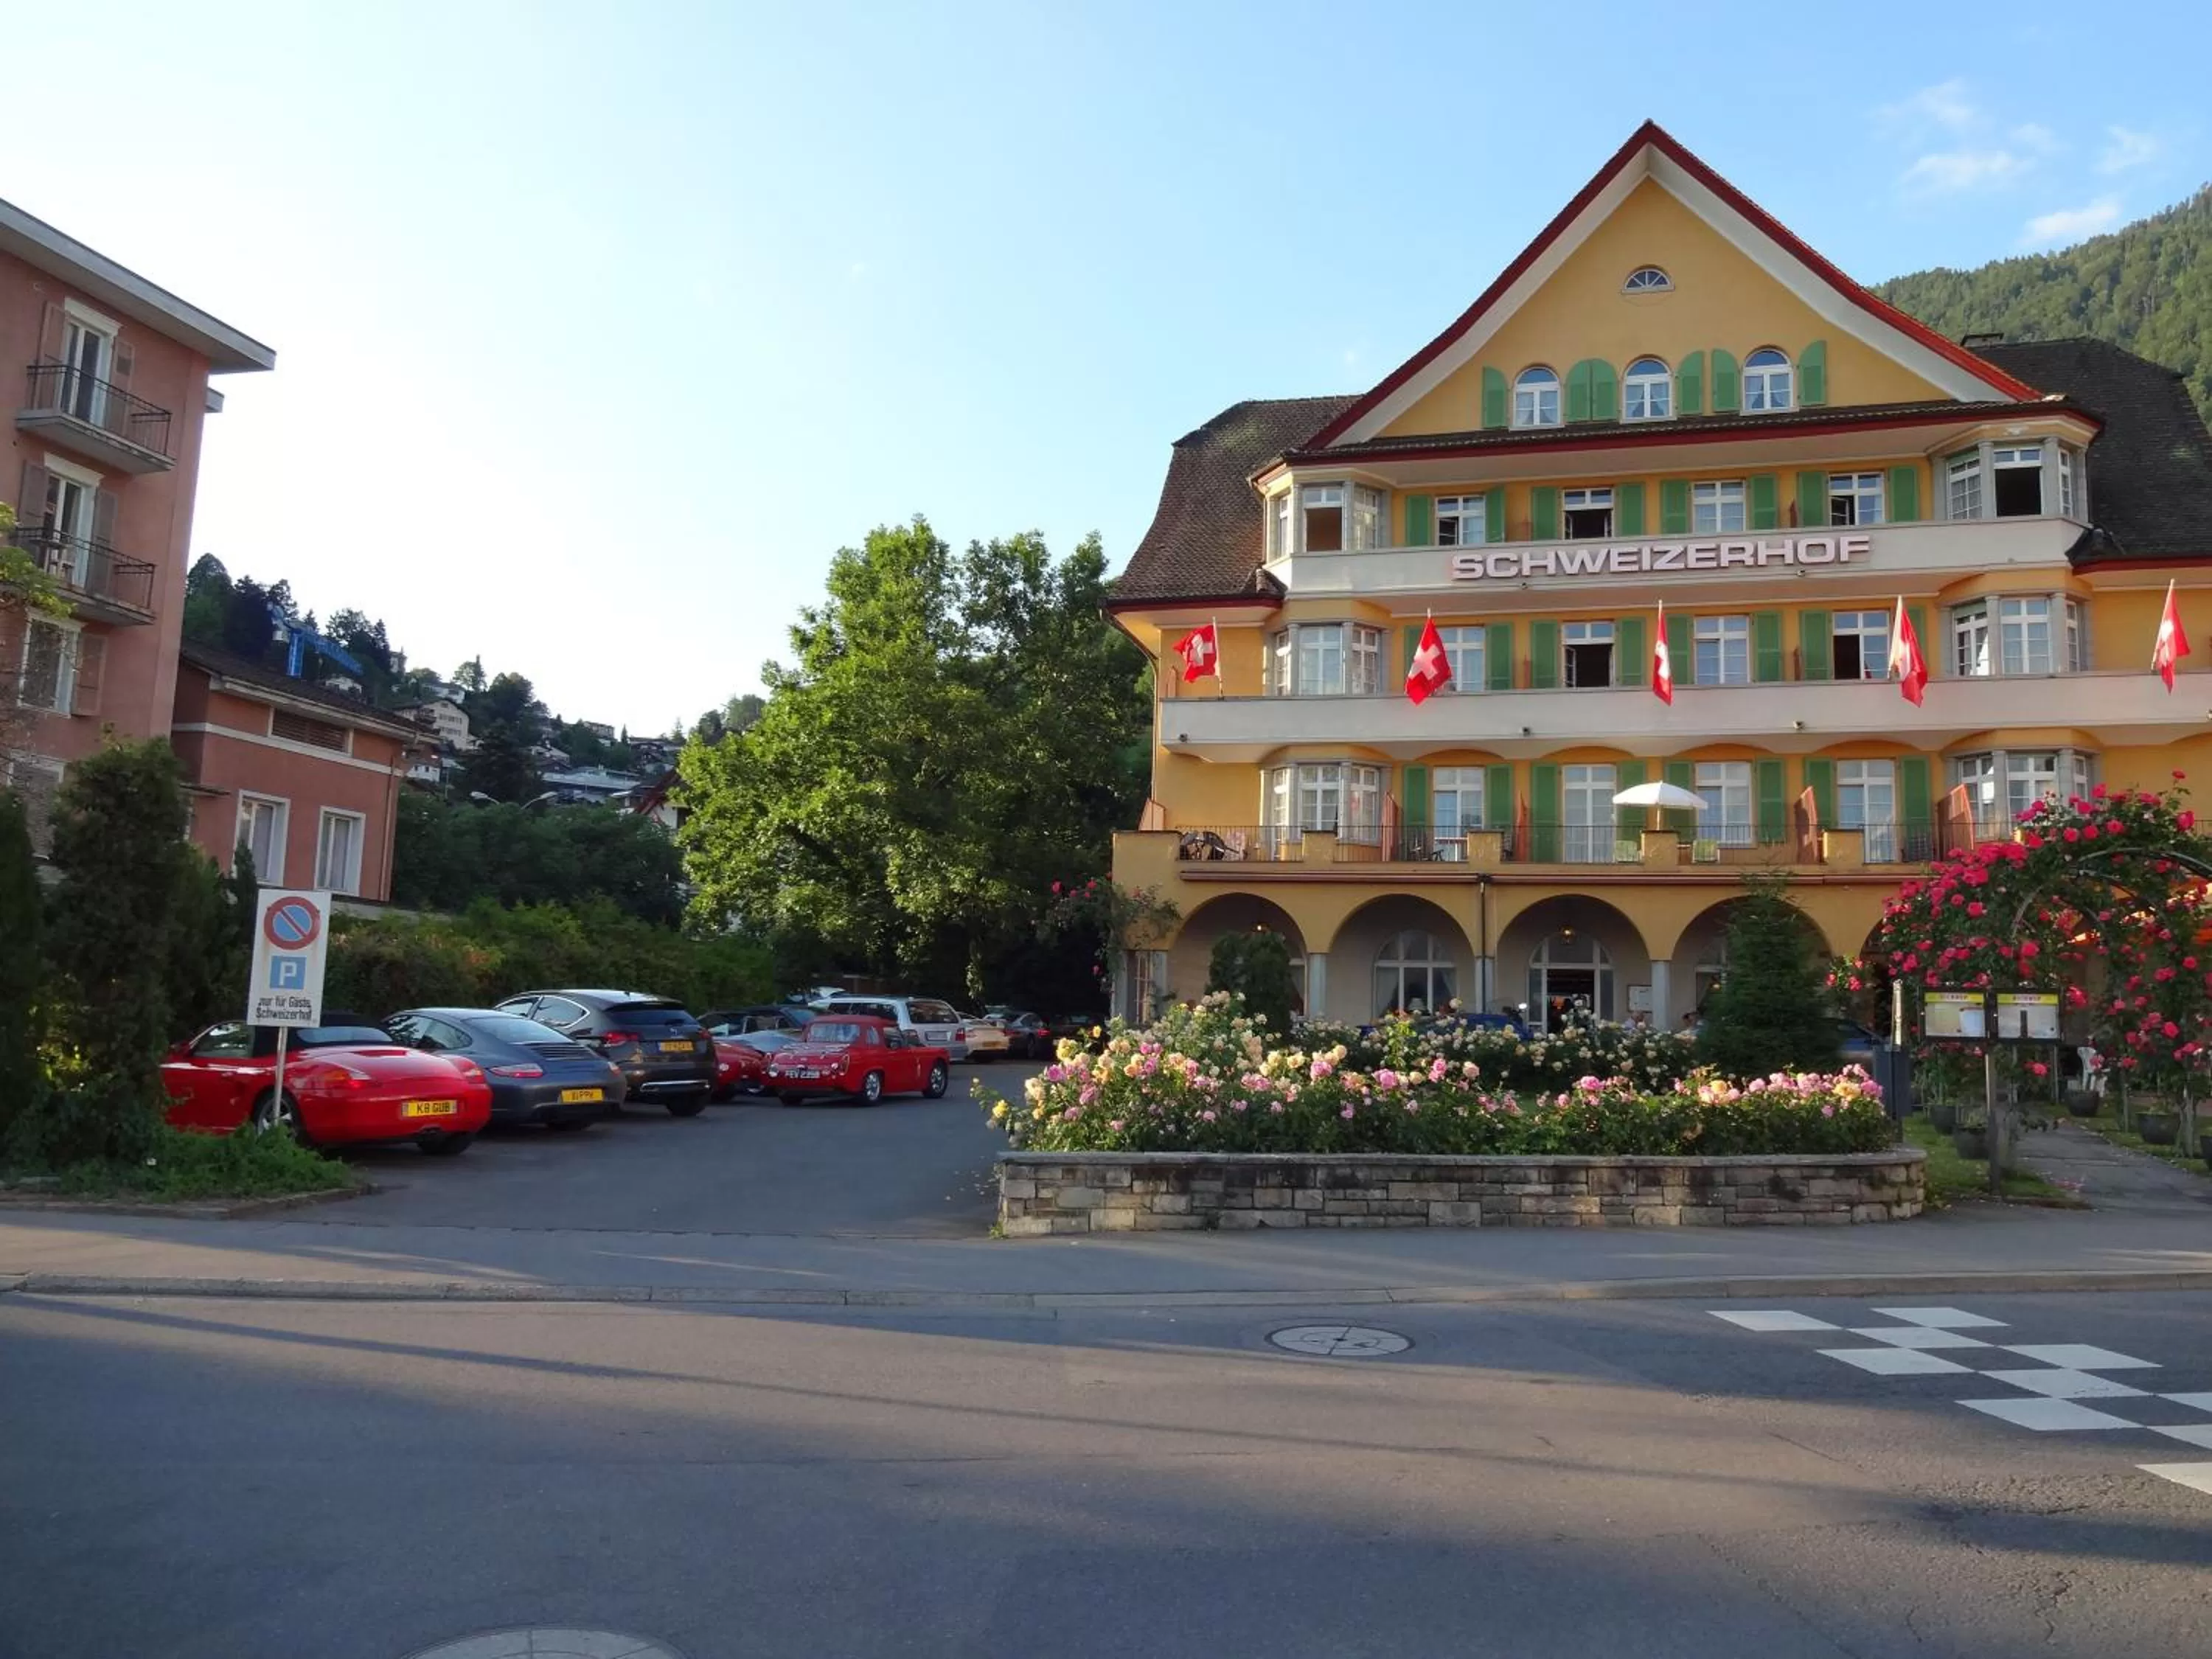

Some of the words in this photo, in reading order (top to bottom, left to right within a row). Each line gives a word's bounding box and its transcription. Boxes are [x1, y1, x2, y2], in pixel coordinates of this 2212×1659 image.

[1451, 535, 1871, 580] SCHWEIZERHOF
[279, 961, 297, 985] P
[256, 1007, 312, 1020] Schweizerhof
